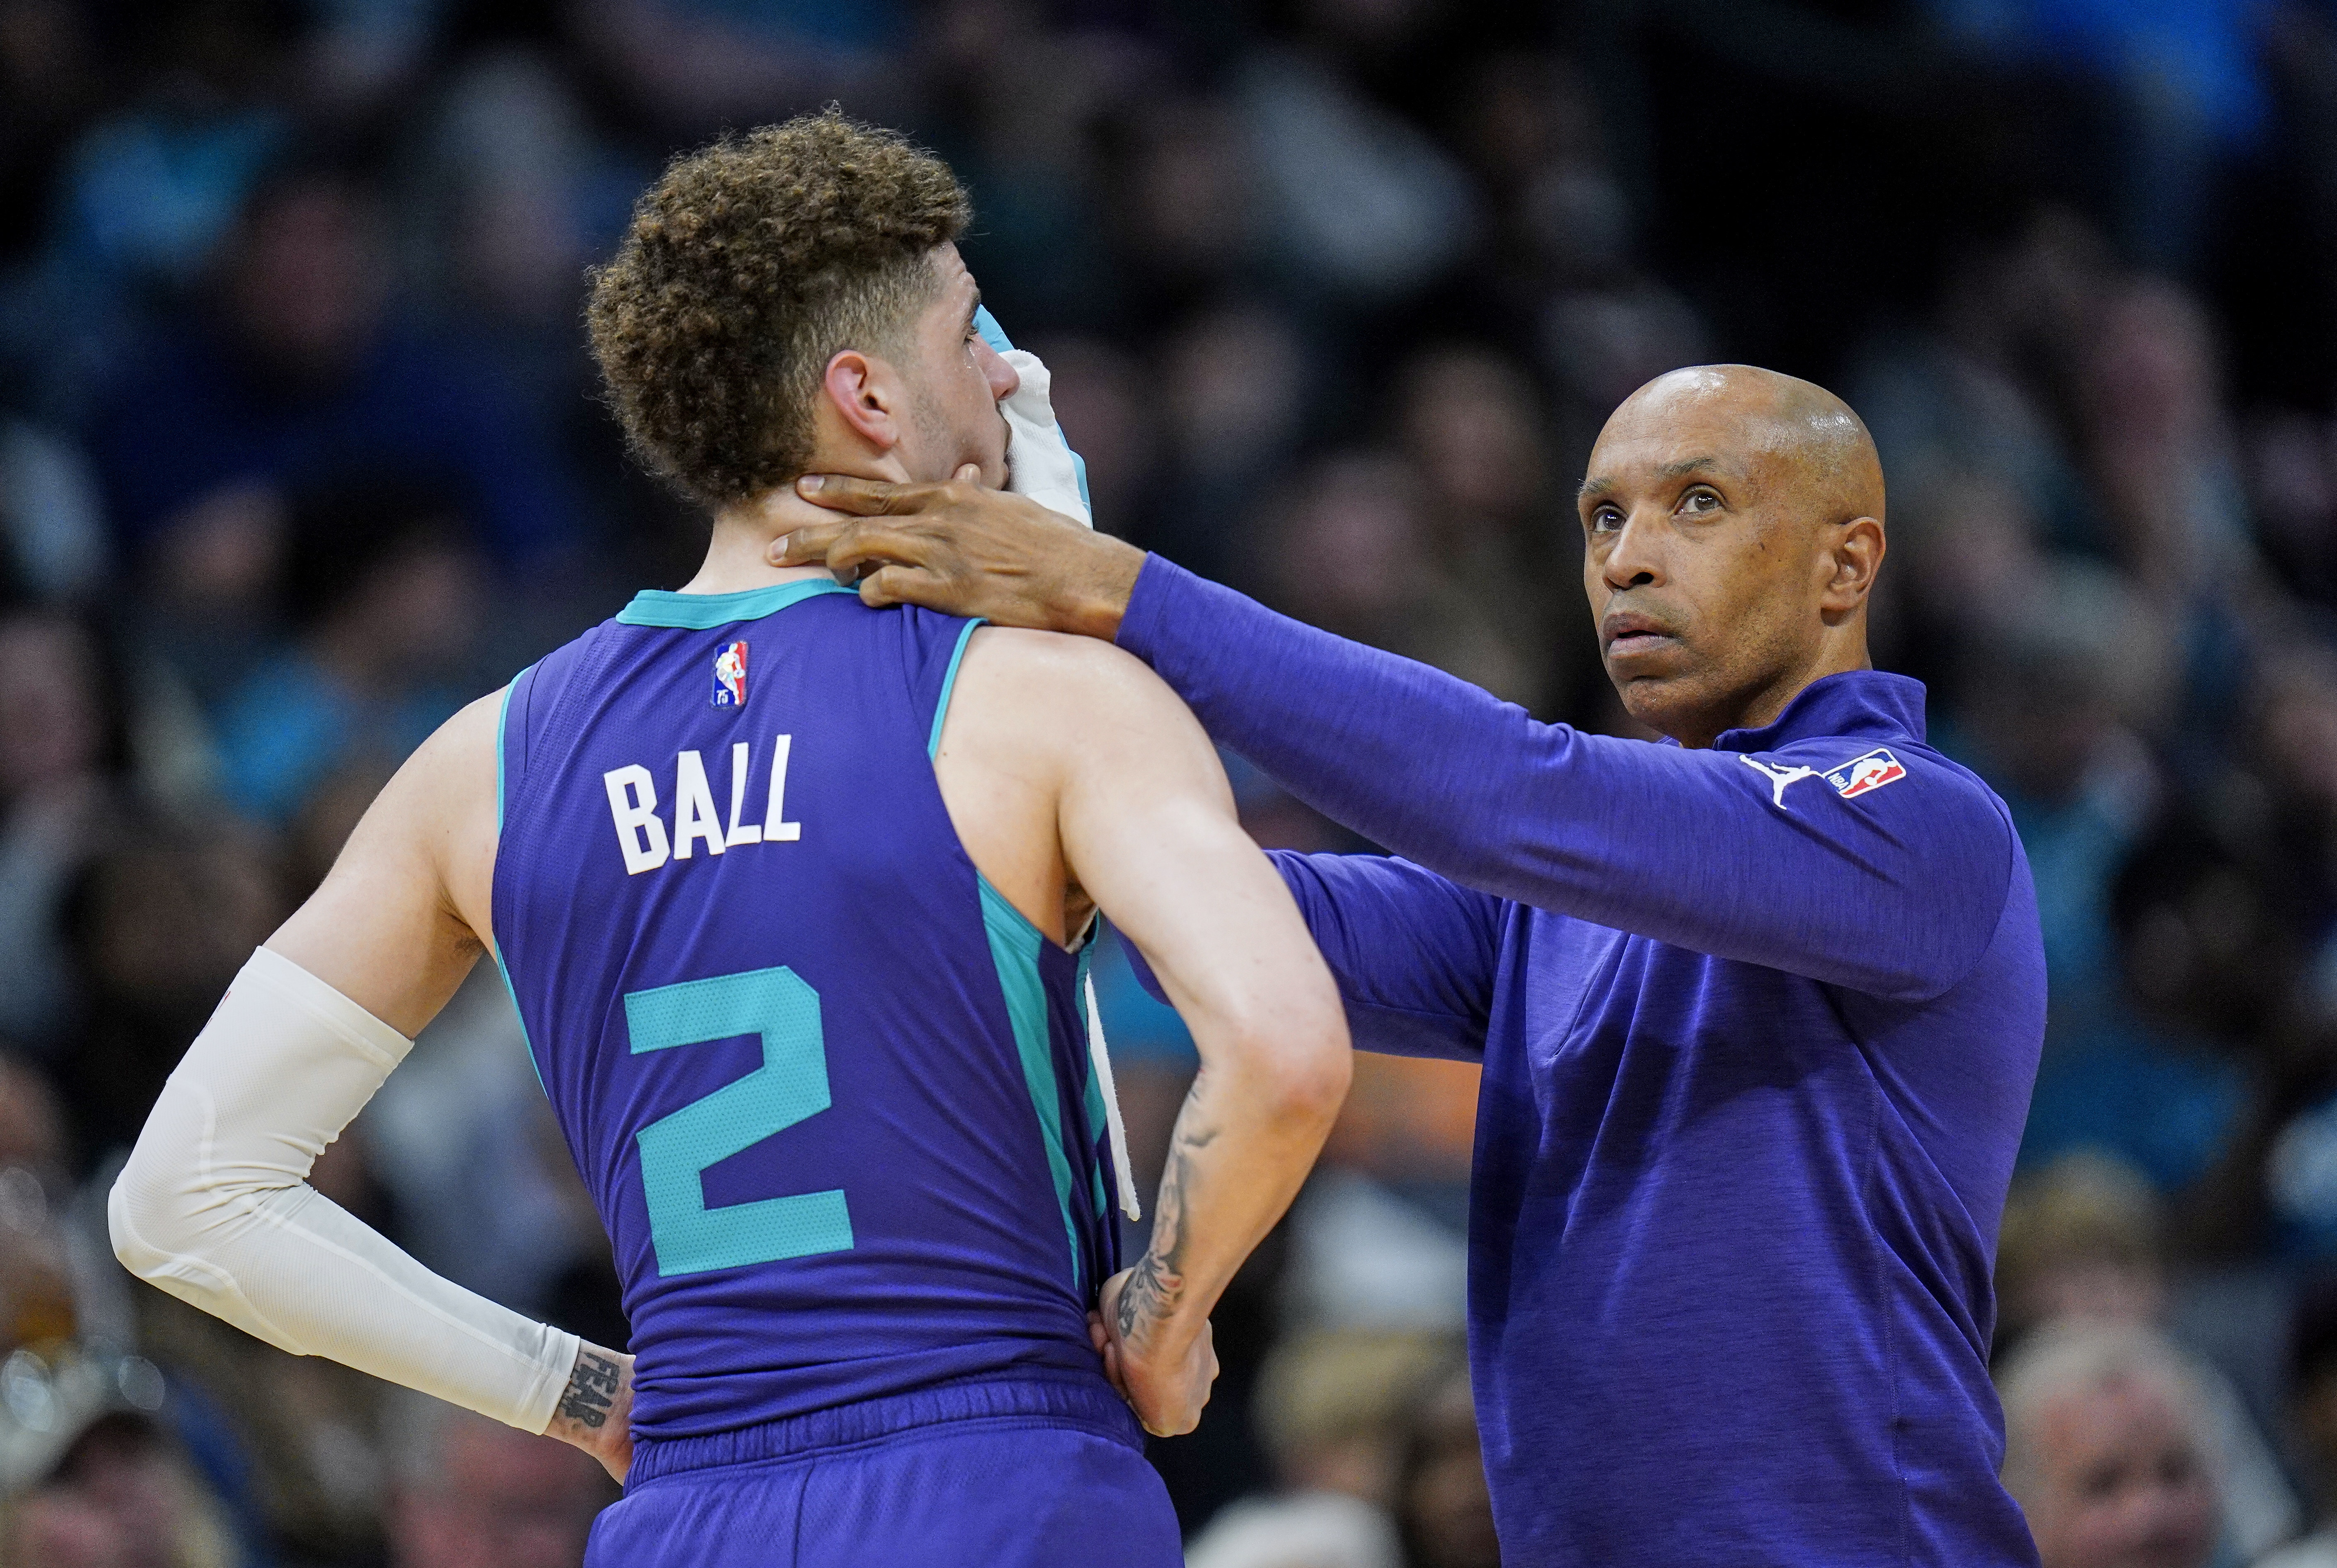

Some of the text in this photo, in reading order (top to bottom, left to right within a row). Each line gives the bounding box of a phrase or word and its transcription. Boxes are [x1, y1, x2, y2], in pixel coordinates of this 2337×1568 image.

[604, 734, 801, 875] BALL
[1828, 772, 1849, 790] NBA
[624, 965, 854, 1277] 2
